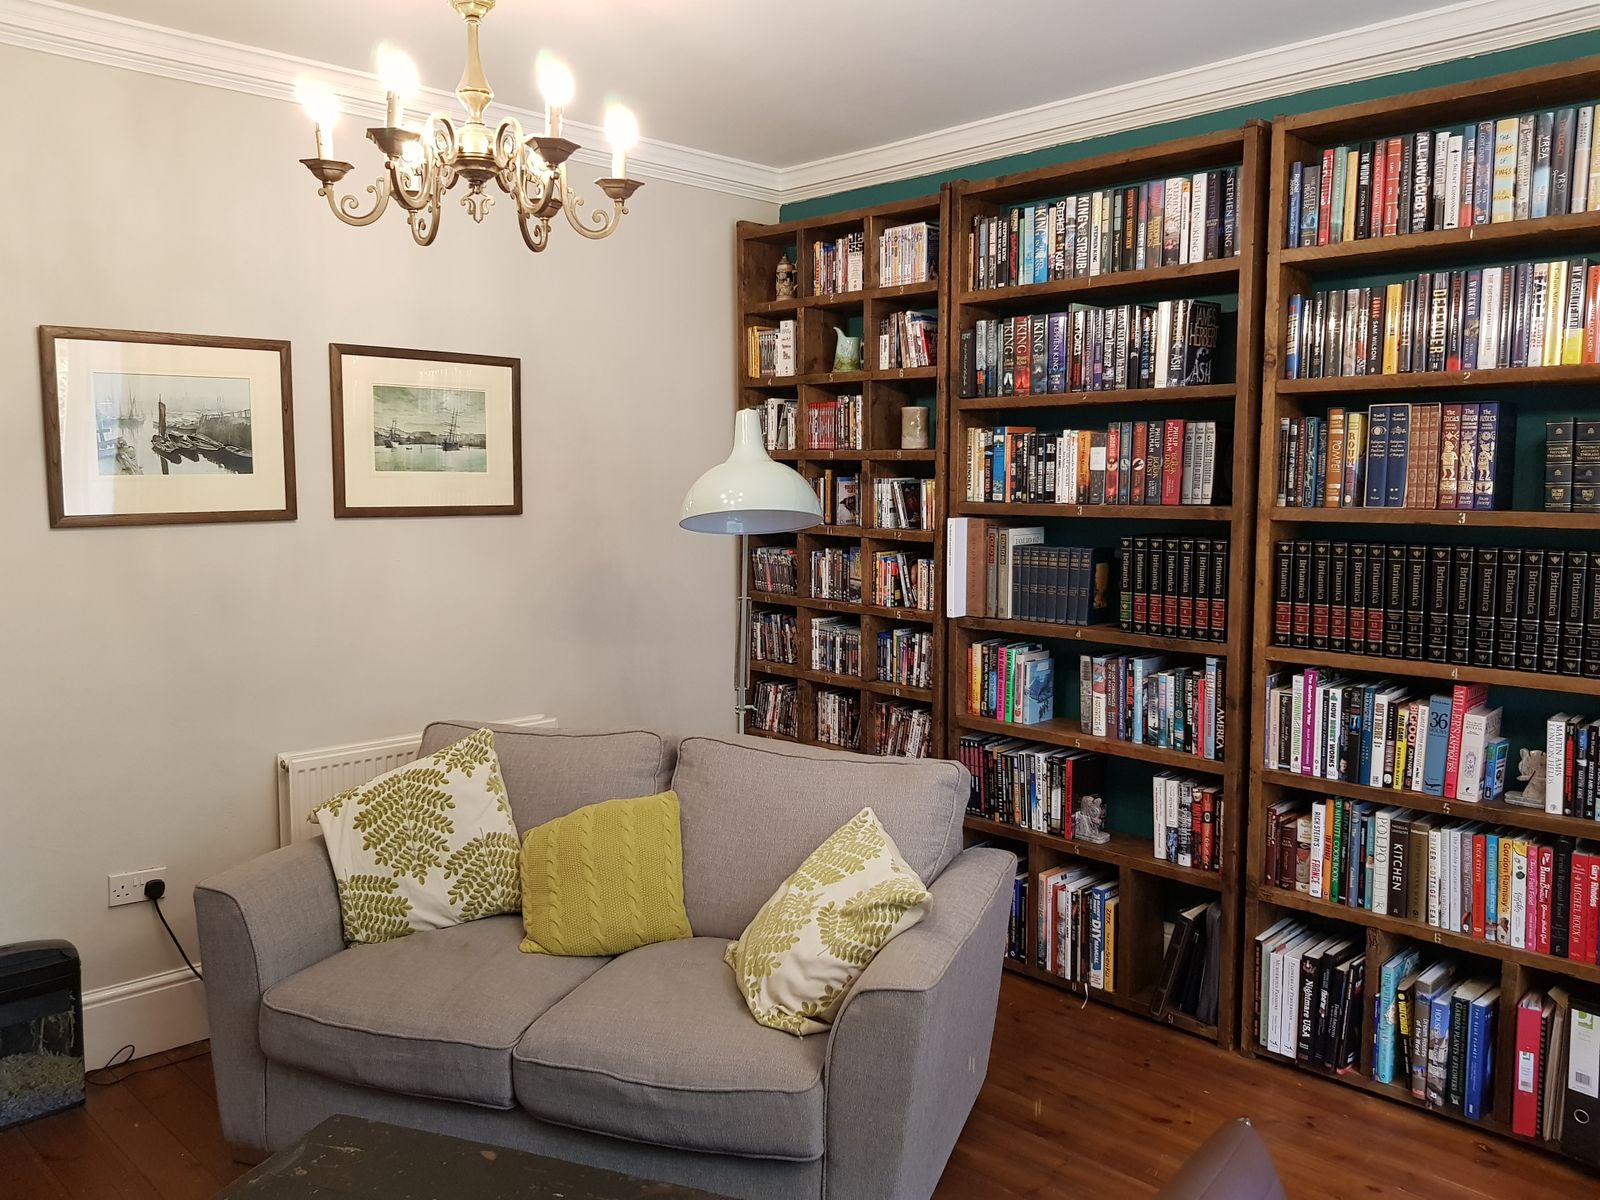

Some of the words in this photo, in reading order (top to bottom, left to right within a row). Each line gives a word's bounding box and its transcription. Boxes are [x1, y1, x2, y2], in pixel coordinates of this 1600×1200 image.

[1362, 152, 1370, 163] THE
[1416, 136, 1428, 156] ALL
[1539, 135, 1551, 159] YRSA
[1360, 163, 1369, 185] WIDOW
[1414, 158, 1428, 211] INVOLVED
[1078, 197, 1090, 223] KING
[1193, 180, 1202, 219] STEPHEN
[1208, 180, 1217, 218] STEPHEN
[1225, 177, 1234, 217] STEPHEN
[1056, 200, 1066, 235] STEPHEN
[1192, 229, 1200, 252] KING
[1207, 226, 1216, 248] KING
[1224, 224, 1233, 247] KING
[1076, 236, 1089, 270] STRAUB
[1573, 265, 1583, 277] MY
[899, 286, 905, 295] 3
[1467, 280, 1478, 316] WRECKER
[1570, 277, 1581, 312] ABSOLUTE
[1196, 305, 1216, 328] JAMES
[1371, 320, 1379, 335] SAM
[1430, 288, 1448, 354] DEFENDER
[1003, 324, 1014, 355] KING
[1016, 323, 1026, 354] KING
[1033, 322, 1044, 353] KING
[1370, 336, 1378, 360] WILSON
[899, 368, 904, 378] 6
[1170, 353, 1183, 371] ASH
[1148, 424, 1156, 452] PULLMAN
[896, 450, 901, 458] 9
[1330, 439, 1342, 473] POMPEII
[1077, 506, 1082, 515] 3
[1459, 513, 1466, 523] 3
[1122, 552, 1130, 588] Britannica
[1136, 553, 1144, 590] Britannica
[1151, 554, 1160, 591] Britannica
[1167, 555, 1175, 592] Britannica
[1182, 556, 1192, 593] Britannica
[1198, 556, 1207, 594] Britannica
[1214, 557, 1224, 595] Britannica
[1280, 558, 1289, 596] Britannica
[1298, 559, 1308, 598] Britannica
[1317, 560, 1326, 600] Britannica
[1335, 561, 1344, 601] Britannica
[1353, 562, 1363, 602] Britannica
[1372, 562, 1381, 604] Britannica
[1391, 563, 1401, 605] Britannica
[1411, 564, 1421, 607] Britannica
[1435, 565, 1446, 608] Britannica
[1458, 567, 1469, 610] Britannica
[1481, 568, 1492, 612] Britannica
[1505, 569, 1516, 613] Britannica
[1527, 570, 1538, 615] Britannica
[1548, 571, 1559, 616] Britannica
[1570, 572, 1581, 618] Britannica
[1452, 669, 1458, 678] 4
[1293, 692, 1302, 721] PRUNING
[1329, 702, 1337, 720] HOW
[1398, 714, 1406, 727] FAIR
[1429, 711, 1449, 730] 36
[1449, 689, 1464, 734] MILLER'S
[1292, 726, 1301, 755] TRAINING
[1397, 727, 1405, 742] GAME
[1407, 705, 1418, 746] BIGFOOT
[1547, 723, 1555, 758] LONDON
[1555, 724, 1563, 756] MARTIN
[1075, 739, 1080, 748] 5
[1328, 743, 1336, 768] WORKS
[1447, 734, 1459, 773] ANTIQUES
[1192, 803, 1202, 833] MUSTAINE
[1333, 808, 1342, 839] MINUTE
[1443, 803, 1450, 813] 5
[1313, 825, 1321, 848] STEIN'S
[1376, 817, 1388, 864] POLPO
[1311, 859, 1320, 885] FRANCE
[1331, 840, 1340, 883] COOKBOOK
[1392, 843, 1404, 891] KITCHEN
[1502, 842, 1512, 873] Gordon
[1589, 864, 1600, 880] Gary
[1429, 866, 1438, 898] COTTAGE
[1500, 874, 1511, 913] Ramsay's
[1573, 882, 1581, 913] MICHEL
[1589, 881, 1599, 907] Rhodes
[1428, 905, 1437, 924] YEAR
[1572, 915, 1580, 935] ROUX
[1091, 918, 1102, 943] DIY
[1434, 933, 1441, 943] 6
[1302, 978, 1314, 1018] Nightmare
[1301, 1019, 1312, 1038] USA
[1398, 1000, 1409, 1035] WATCHMEN
[1422, 1018, 1430, 1037] Dream
[1433, 1008, 1443, 1035] HOUSES
[1454, 1002, 1463, 1029] GARDEN
[1421, 1037, 1429, 1057] Routes
[1453, 1030, 1461, 1055] PLANTS
[1451, 1062, 1459, 1091] FLOWERS
